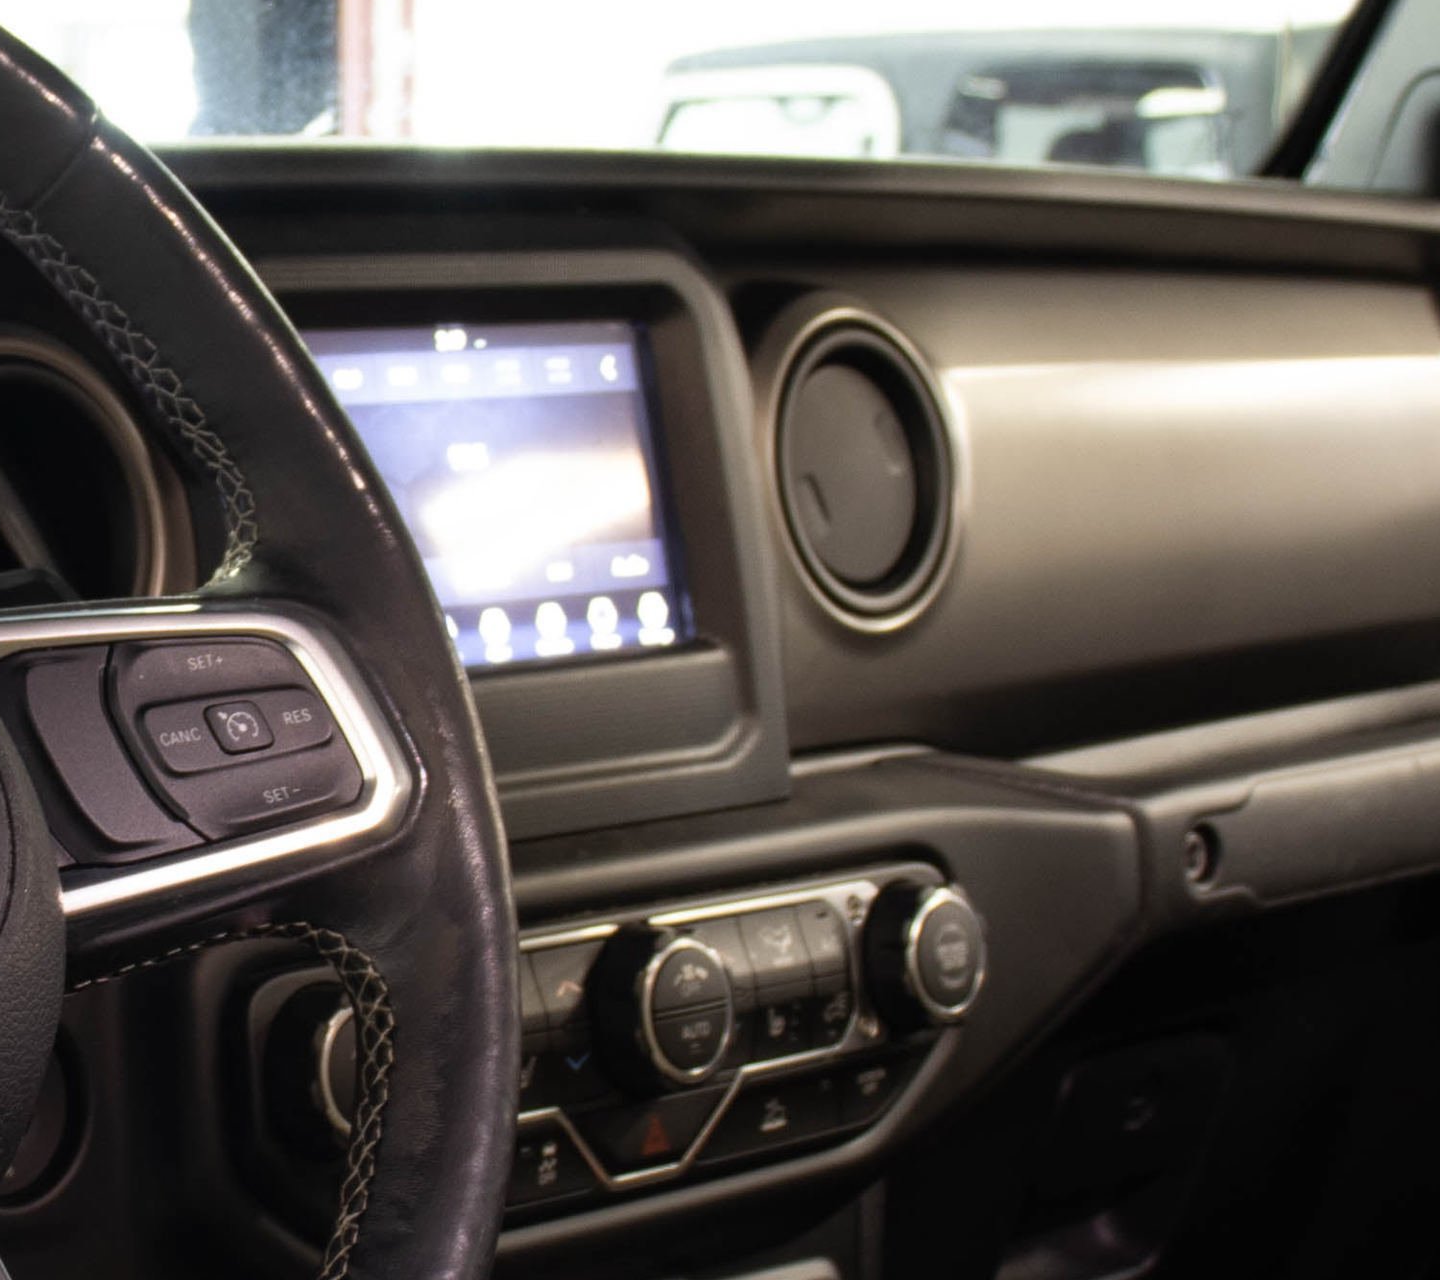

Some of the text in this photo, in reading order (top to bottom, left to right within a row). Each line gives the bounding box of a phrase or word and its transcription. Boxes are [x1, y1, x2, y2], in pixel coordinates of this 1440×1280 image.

[282, 707, 312, 725] RES
[159, 726, 202, 747] CANC
[681, 1020, 711, 1040] AUTO
